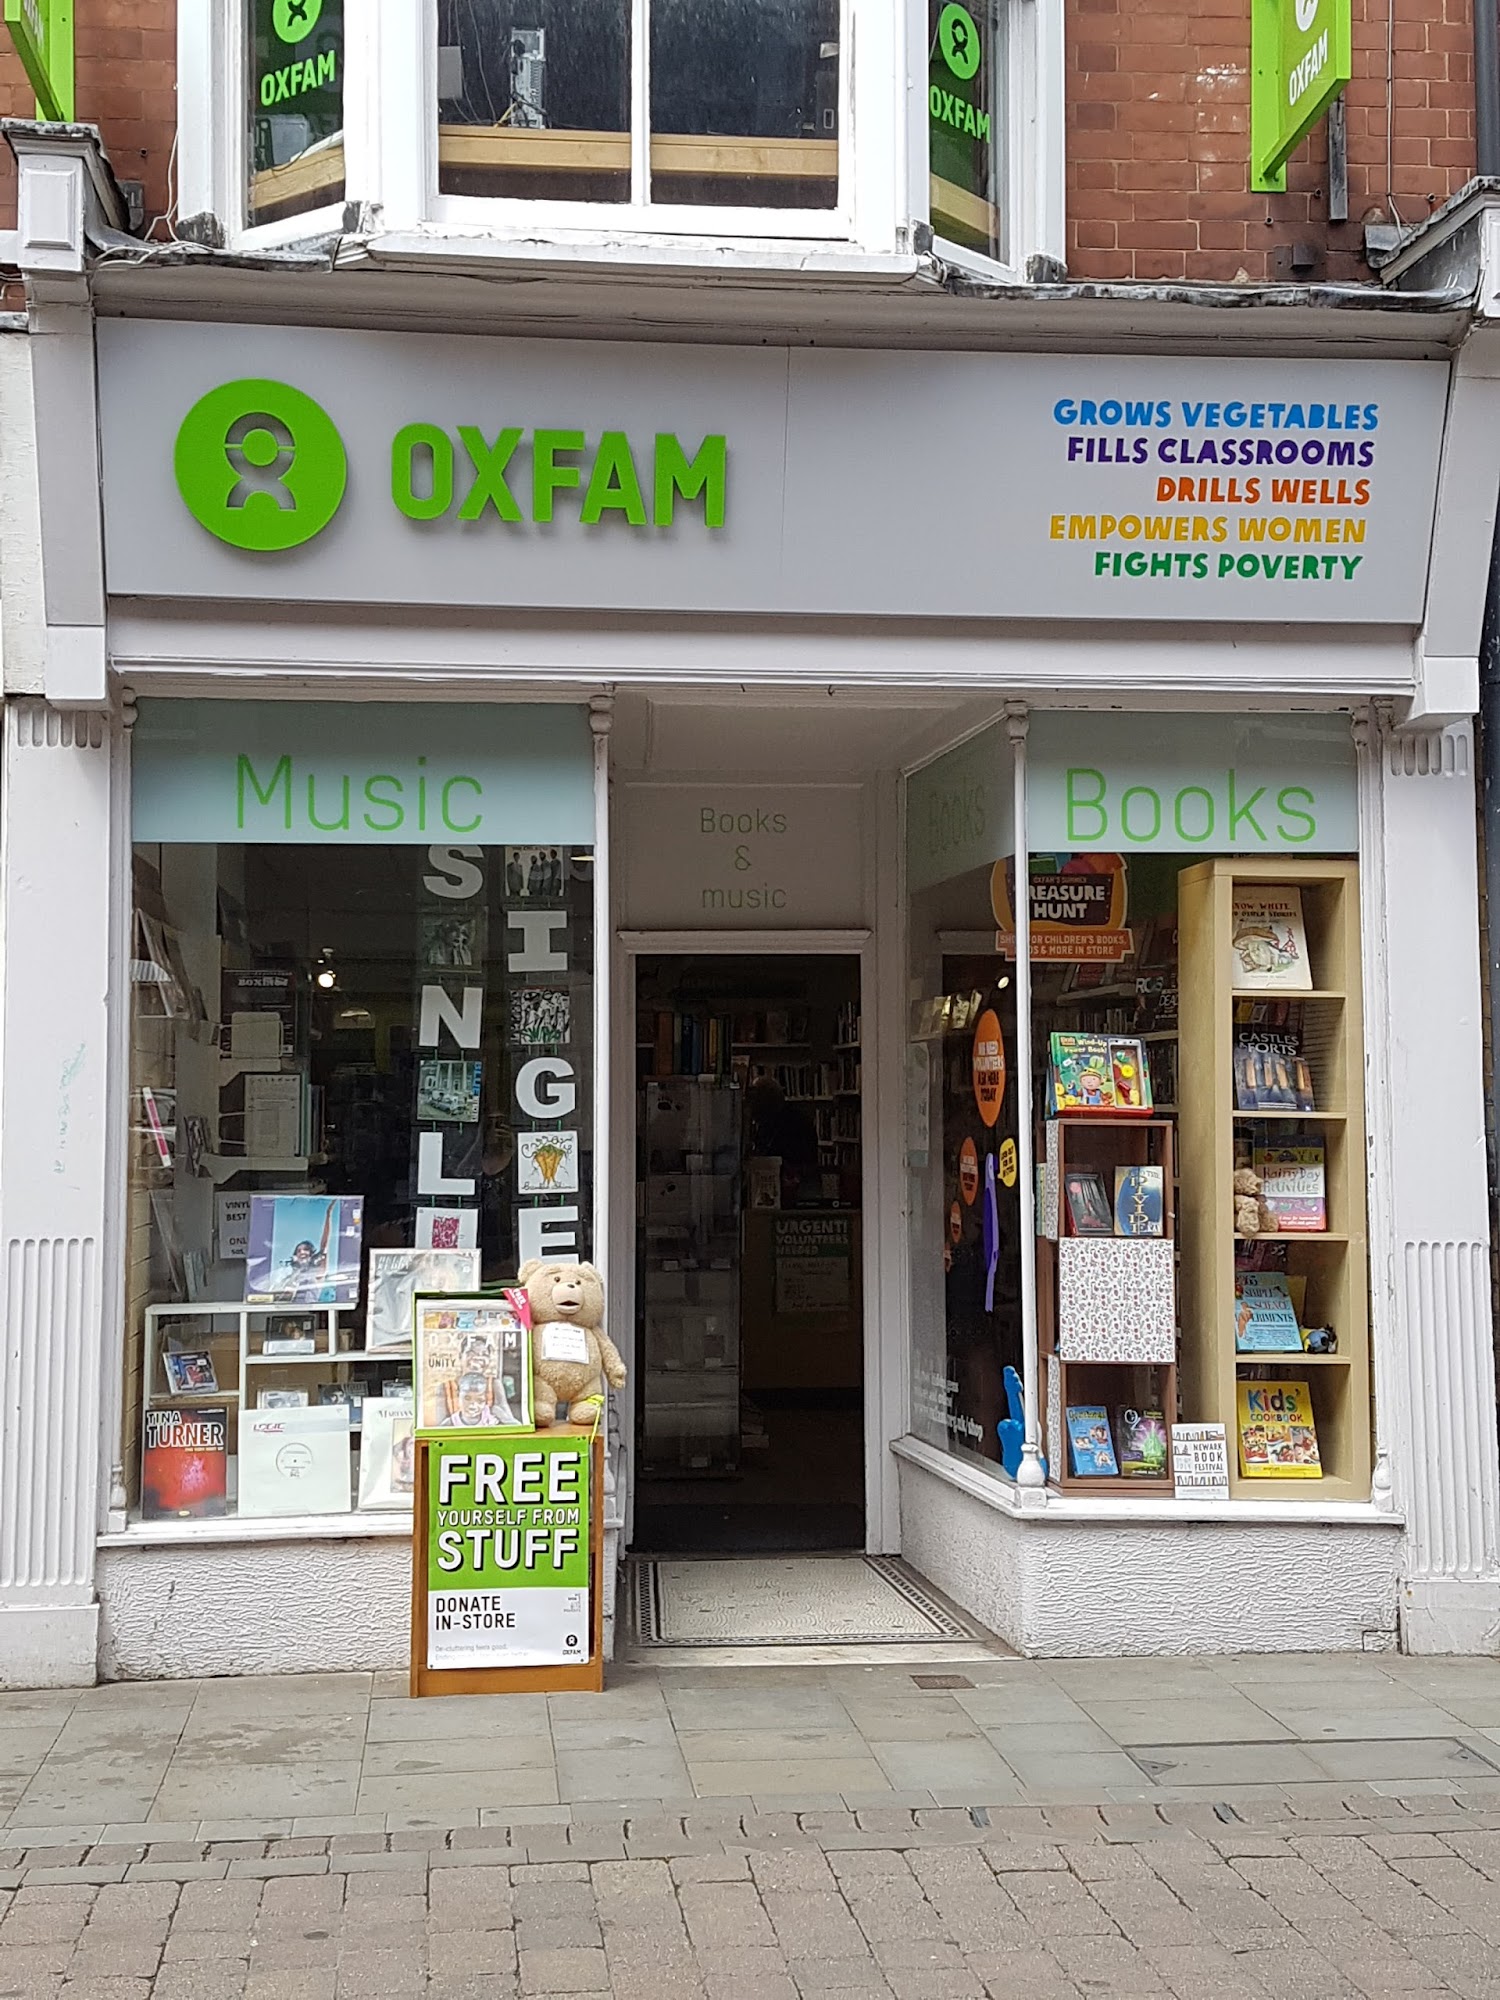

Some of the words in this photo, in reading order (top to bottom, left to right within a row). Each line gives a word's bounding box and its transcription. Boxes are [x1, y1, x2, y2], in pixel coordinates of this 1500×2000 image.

[1290, 28, 1328, 106] OXFAM
[261, 49, 335, 106] OXFAM
[930, 85, 991, 144] OXFAM
[1053, 399, 1171, 428] GROWS
[1182, 401, 1379, 431] VEGETABLES
[1067, 437, 1149, 464] FILLS
[1157, 438, 1374, 467] CLASSROOMS
[391, 423, 727, 527] OXFAM
[1156, 477, 1261, 504] DRILLS
[1271, 478, 1370, 505] WELLS
[1049, 514, 1228, 542] EMPOWERS
[1238, 516, 1366, 543] WOMEN
[1094, 552, 1208, 579] FIGHTS
[1218, 553, 1363, 580] POVERTY
[236, 754, 483, 833] Music
[1066, 768, 1316, 843] Books
[701, 807, 787, 833] Books
[735, 845, 751, 870] &
[702, 882, 787, 909] music
[1028, 885, 1106, 901] REASURE
[1034, 902, 1087, 919] HUNT
[1044, 935, 1094, 944] CHILDREN'S
[1049, 945, 1073, 955] MORE
[1075, 945, 1085, 955] IN
[1086, 945, 1114, 955] STORE
[1239, 1032, 1299, 1047] CASTLES
[1247, 1043, 1297, 1056] FORTS
[1263, 1167, 1297, 1181] Rainy
[1298, 1167, 1321, 1182] Day
[226, 1213, 247, 1221] BEST
[776, 1219, 848, 1234] URGENT!
[776, 1234, 849, 1245] VOLUNTEERS
[428, 1358, 456, 1368] UNITY
[1247, 1388, 1301, 1413] Kids'
[147, 1411, 182, 1425] TINA
[1250, 1413, 1303, 1423] COOKBOOK
[147, 1423, 224, 1449] TURNER
[1193, 1443, 1223, 1451] NEWARK
[1194, 1452, 1224, 1463] BOOK
[1194, 1463, 1224, 1471] FESTIVAL
[439, 1452, 579, 1505] FREE
[437, 1509, 527, 1526] YOURSELF
[532, 1507, 580, 1525] FROM
[437, 1528, 579, 1572] STUFF
[436, 1596, 501, 1613] DONATE
[436, 1613, 516, 1631] IN-STORE
